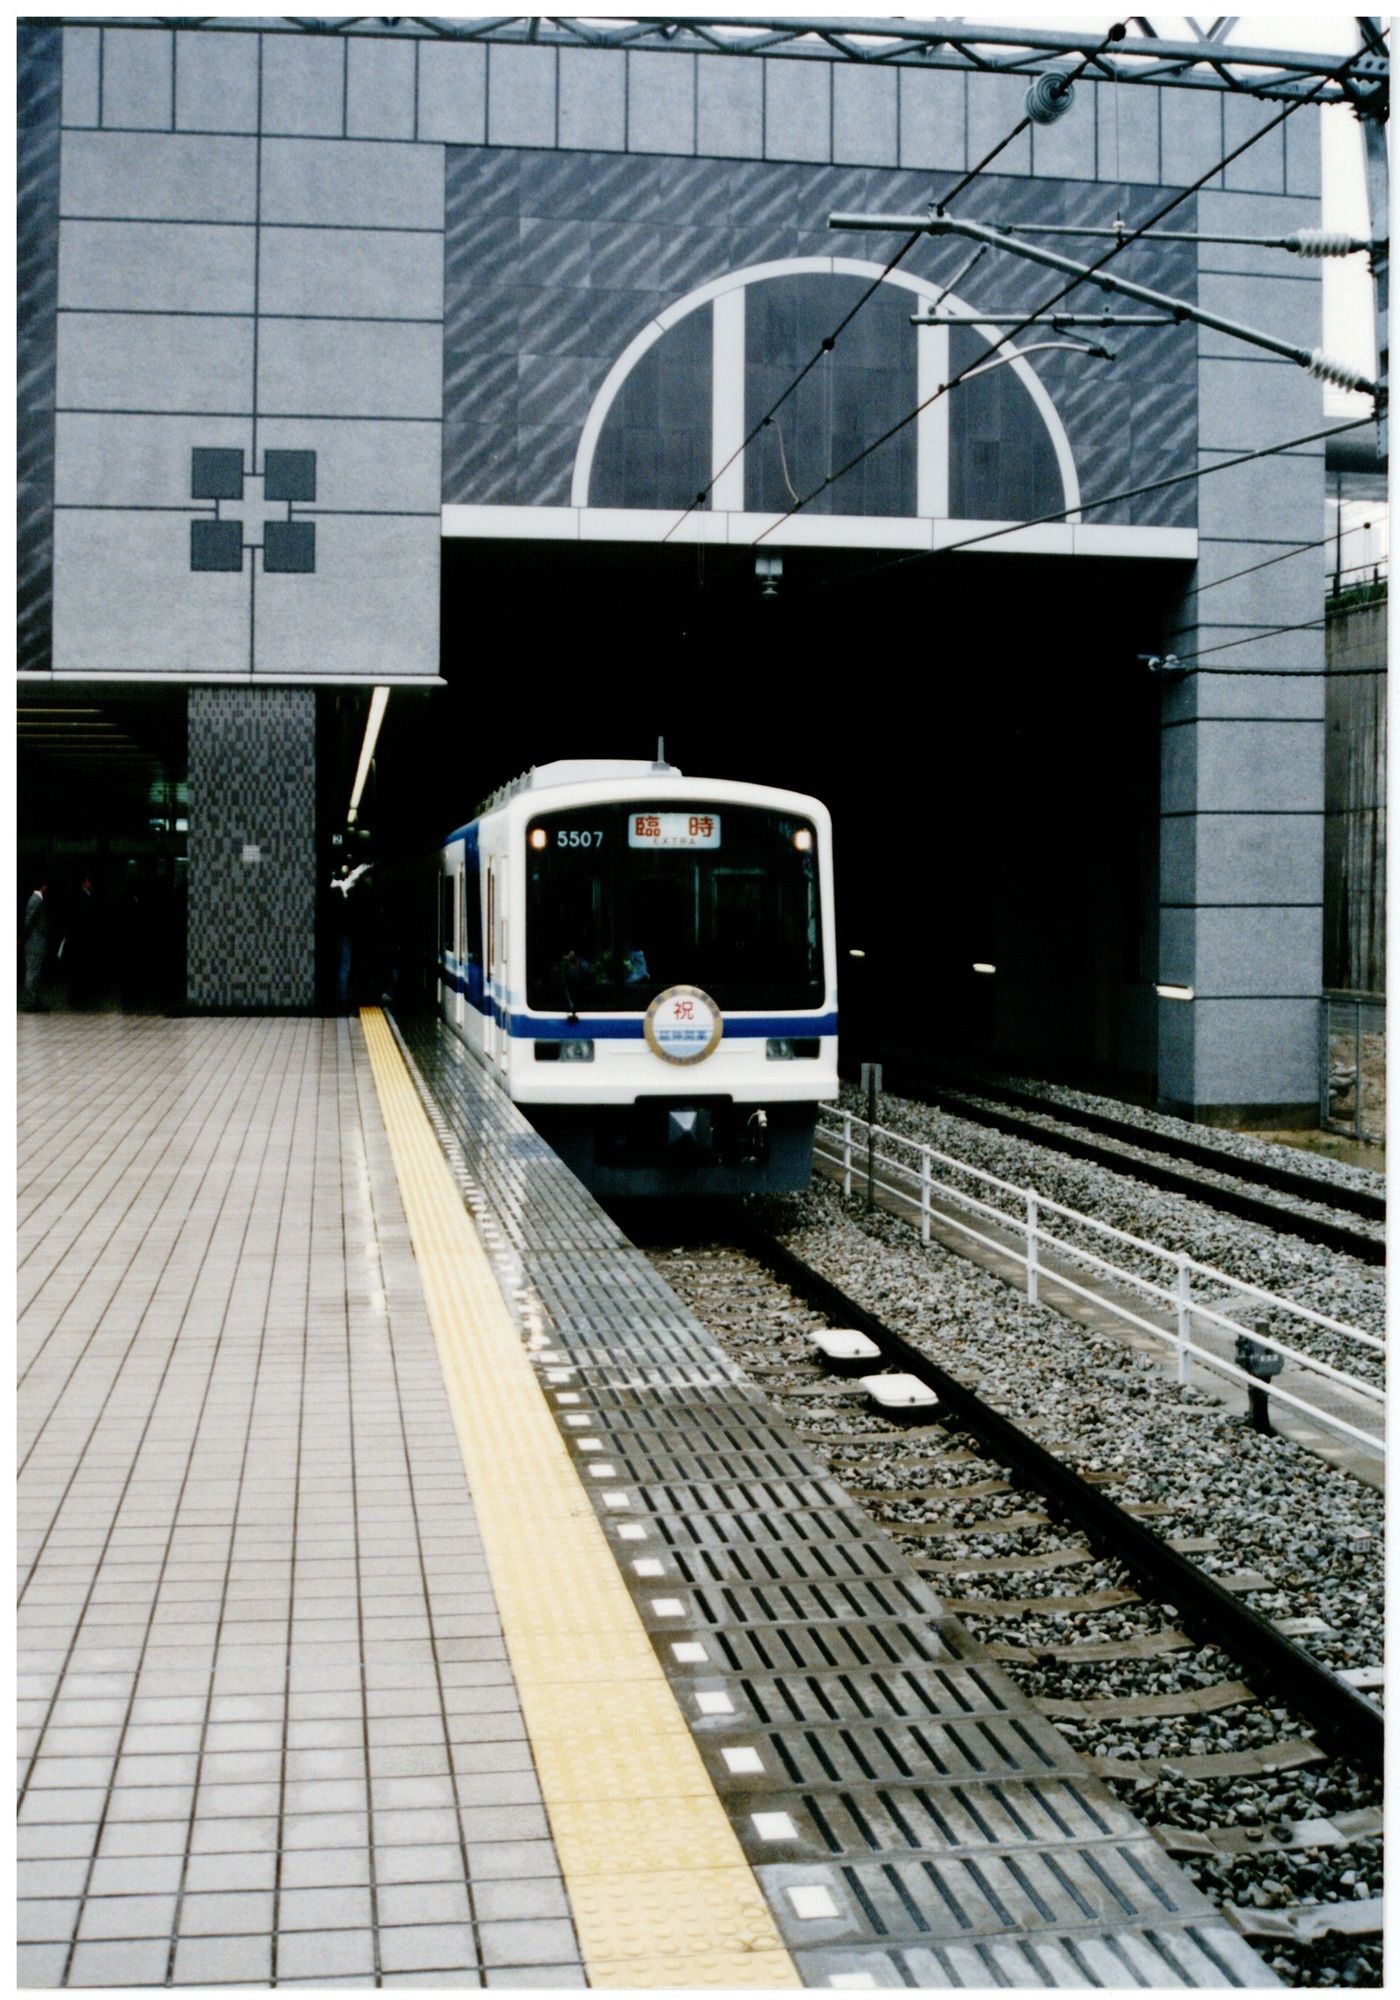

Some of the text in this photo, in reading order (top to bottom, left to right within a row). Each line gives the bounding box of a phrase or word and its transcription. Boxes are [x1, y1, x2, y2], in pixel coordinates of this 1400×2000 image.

[635, 815, 714, 837] 臨時
[556, 830, 604, 848] 5507
[653, 837, 696, 846] EXTRA
[673, 1001, 694, 1020] 祝
